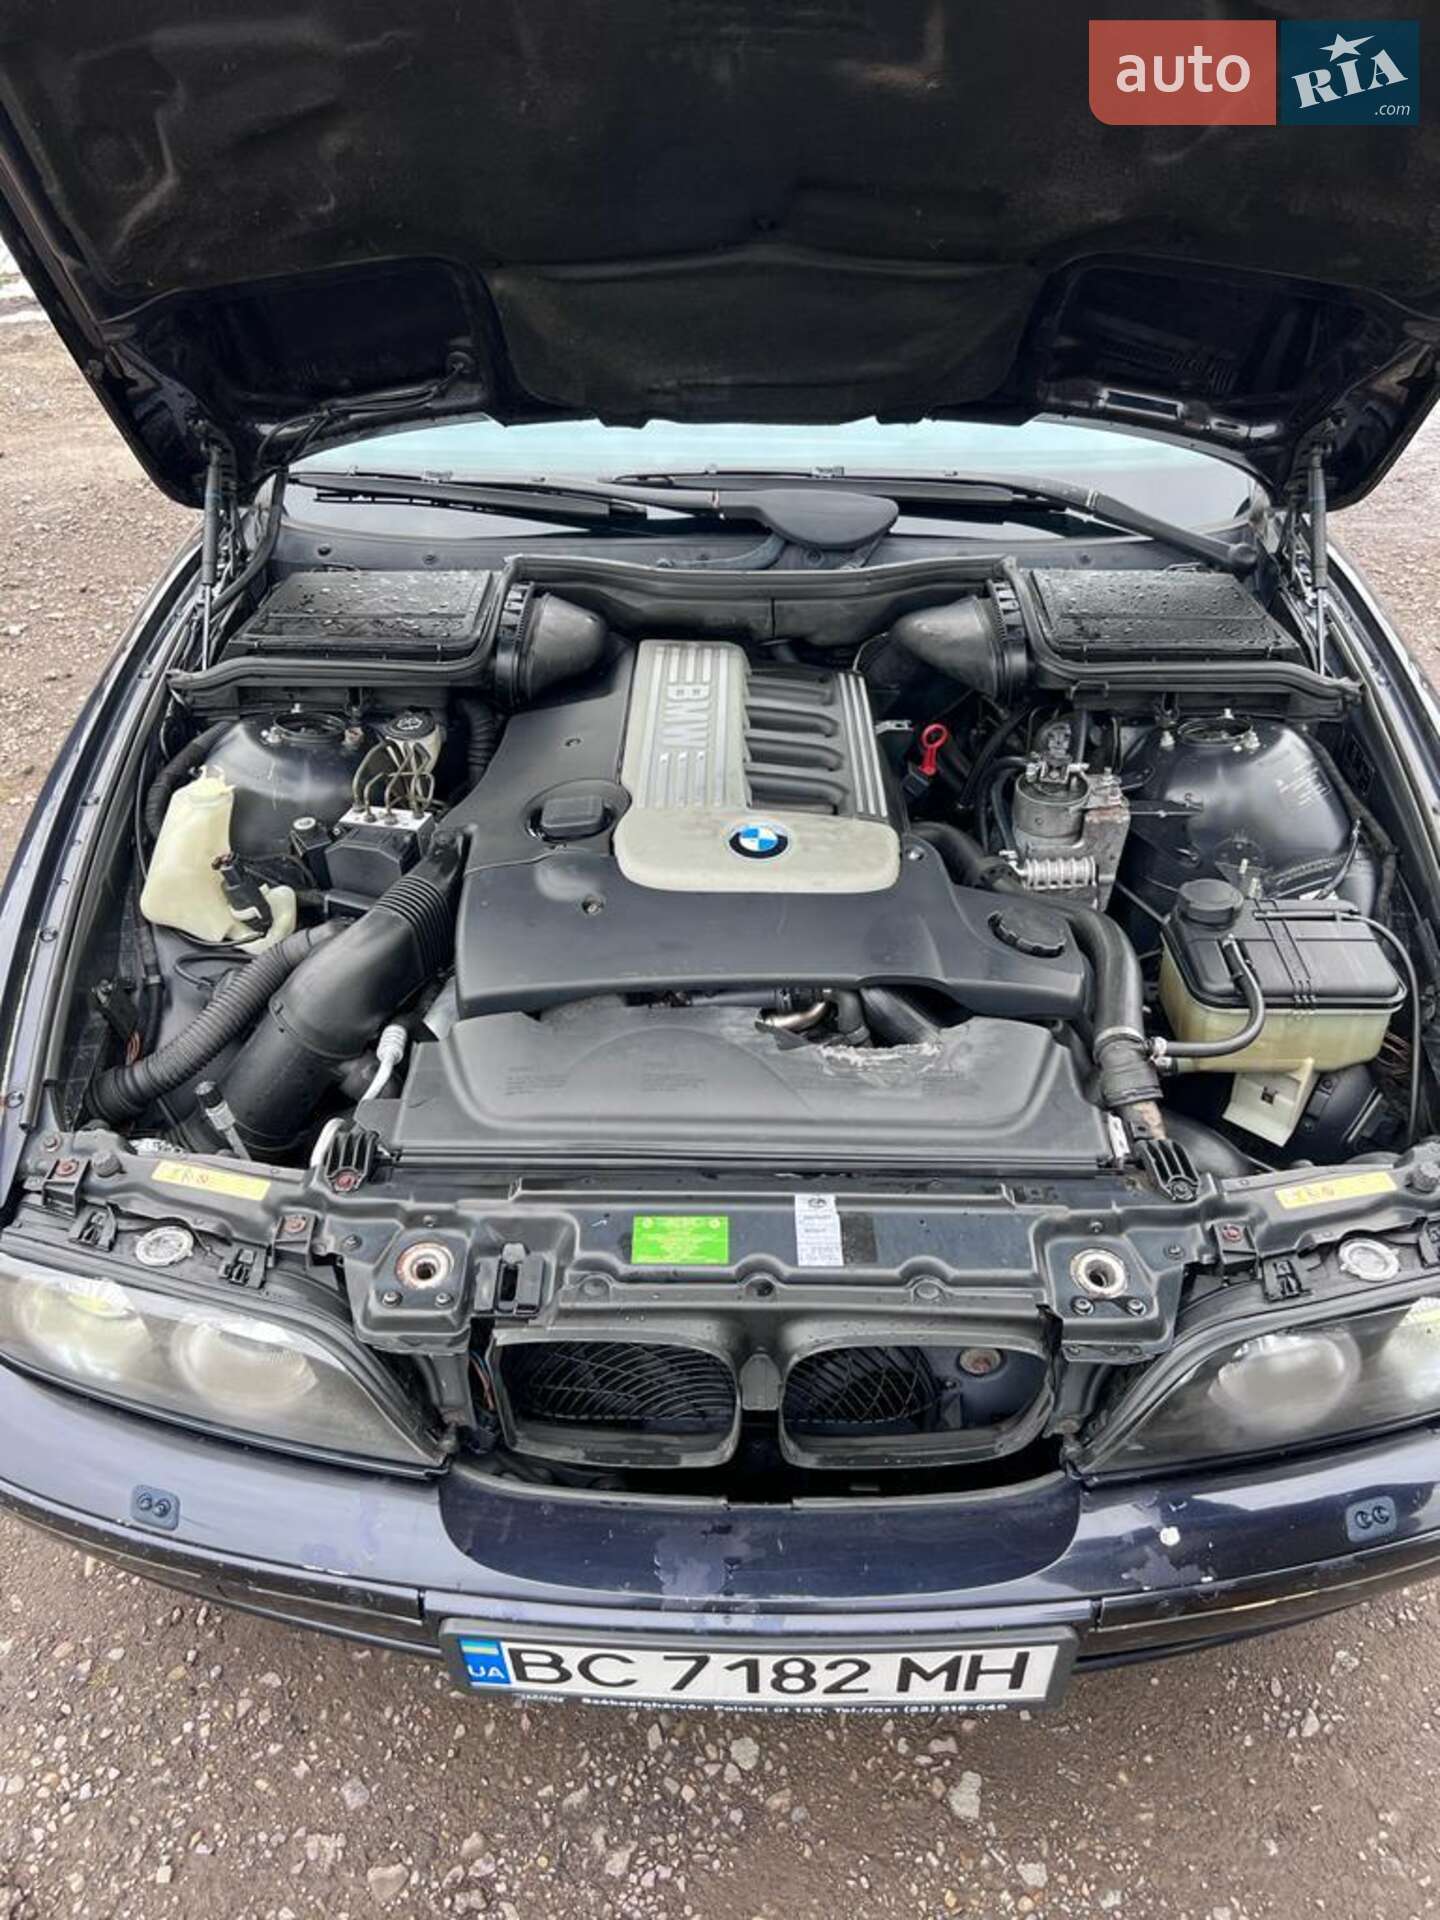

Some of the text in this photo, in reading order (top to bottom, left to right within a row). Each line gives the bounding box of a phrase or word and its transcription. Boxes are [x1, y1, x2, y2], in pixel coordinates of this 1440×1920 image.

[662, 683, 711, 749] BMW
[467, 1664, 505, 1679] UA
[507, 1647, 1030, 1694] BC 7182 MH
